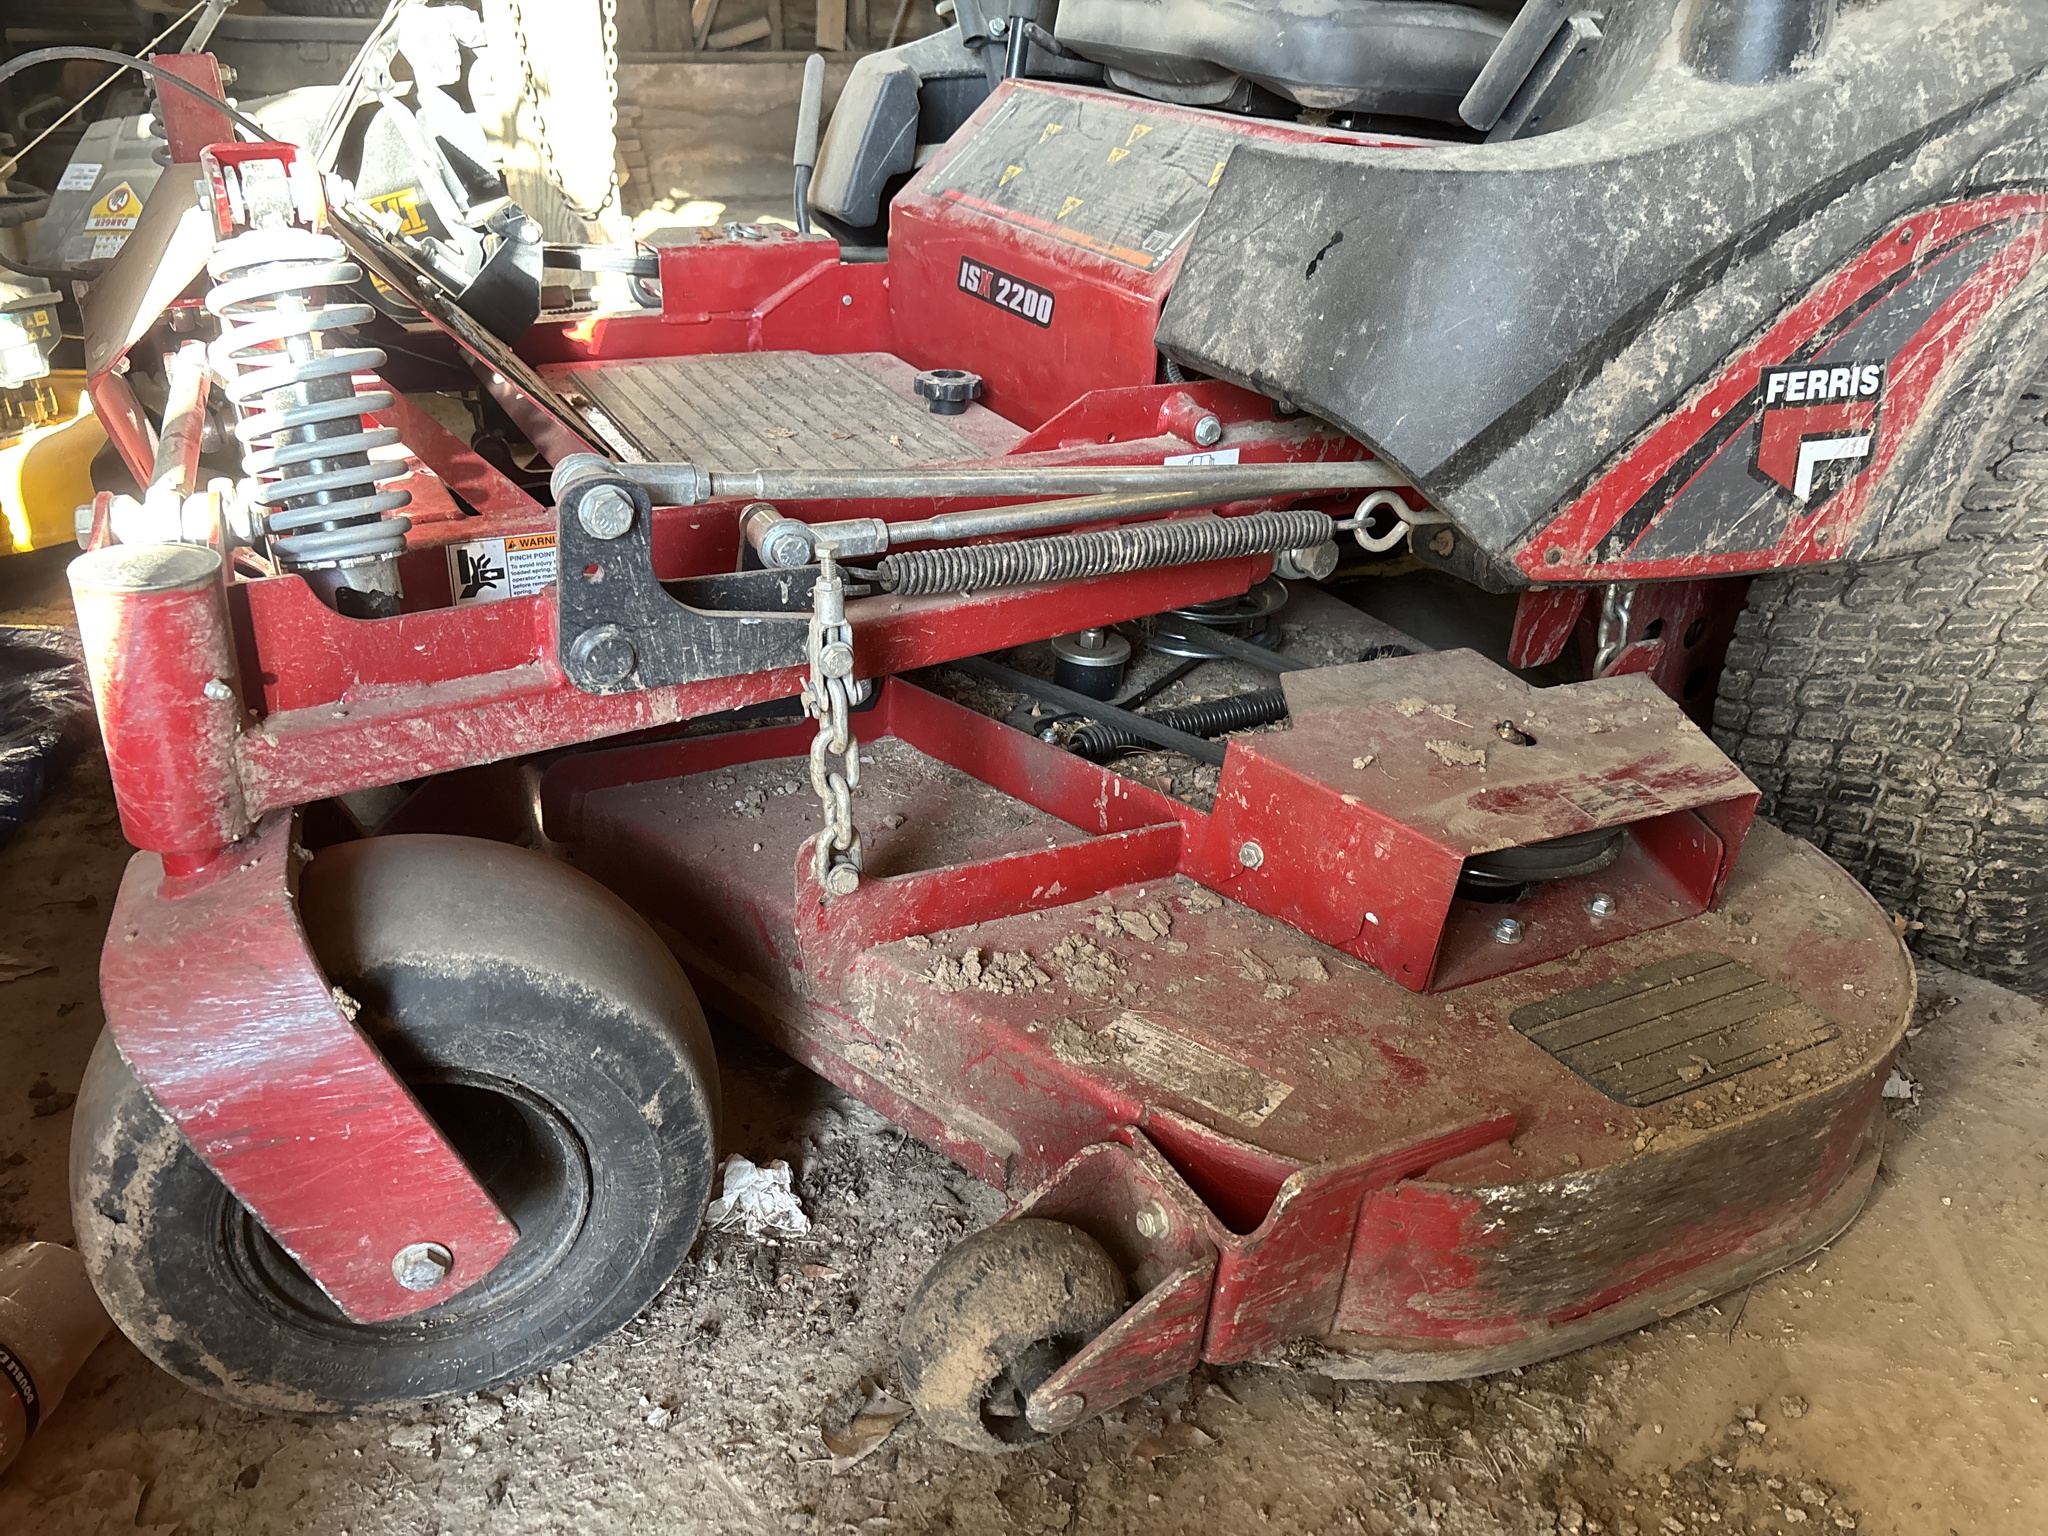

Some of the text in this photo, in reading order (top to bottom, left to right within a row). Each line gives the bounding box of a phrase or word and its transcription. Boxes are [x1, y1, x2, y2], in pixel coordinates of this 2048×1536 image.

[94, 217, 129, 228] DANGER
[959, 261, 1054, 325] ISX 2200
[1766, 366, 1881, 404] FERRIS
[519, 536, 555, 547] WARNI
[512, 575, 541, 583] operator's
[1177, 1035, 1194, 1048] and
[6, 1360, 35, 1405] DOUBLE
